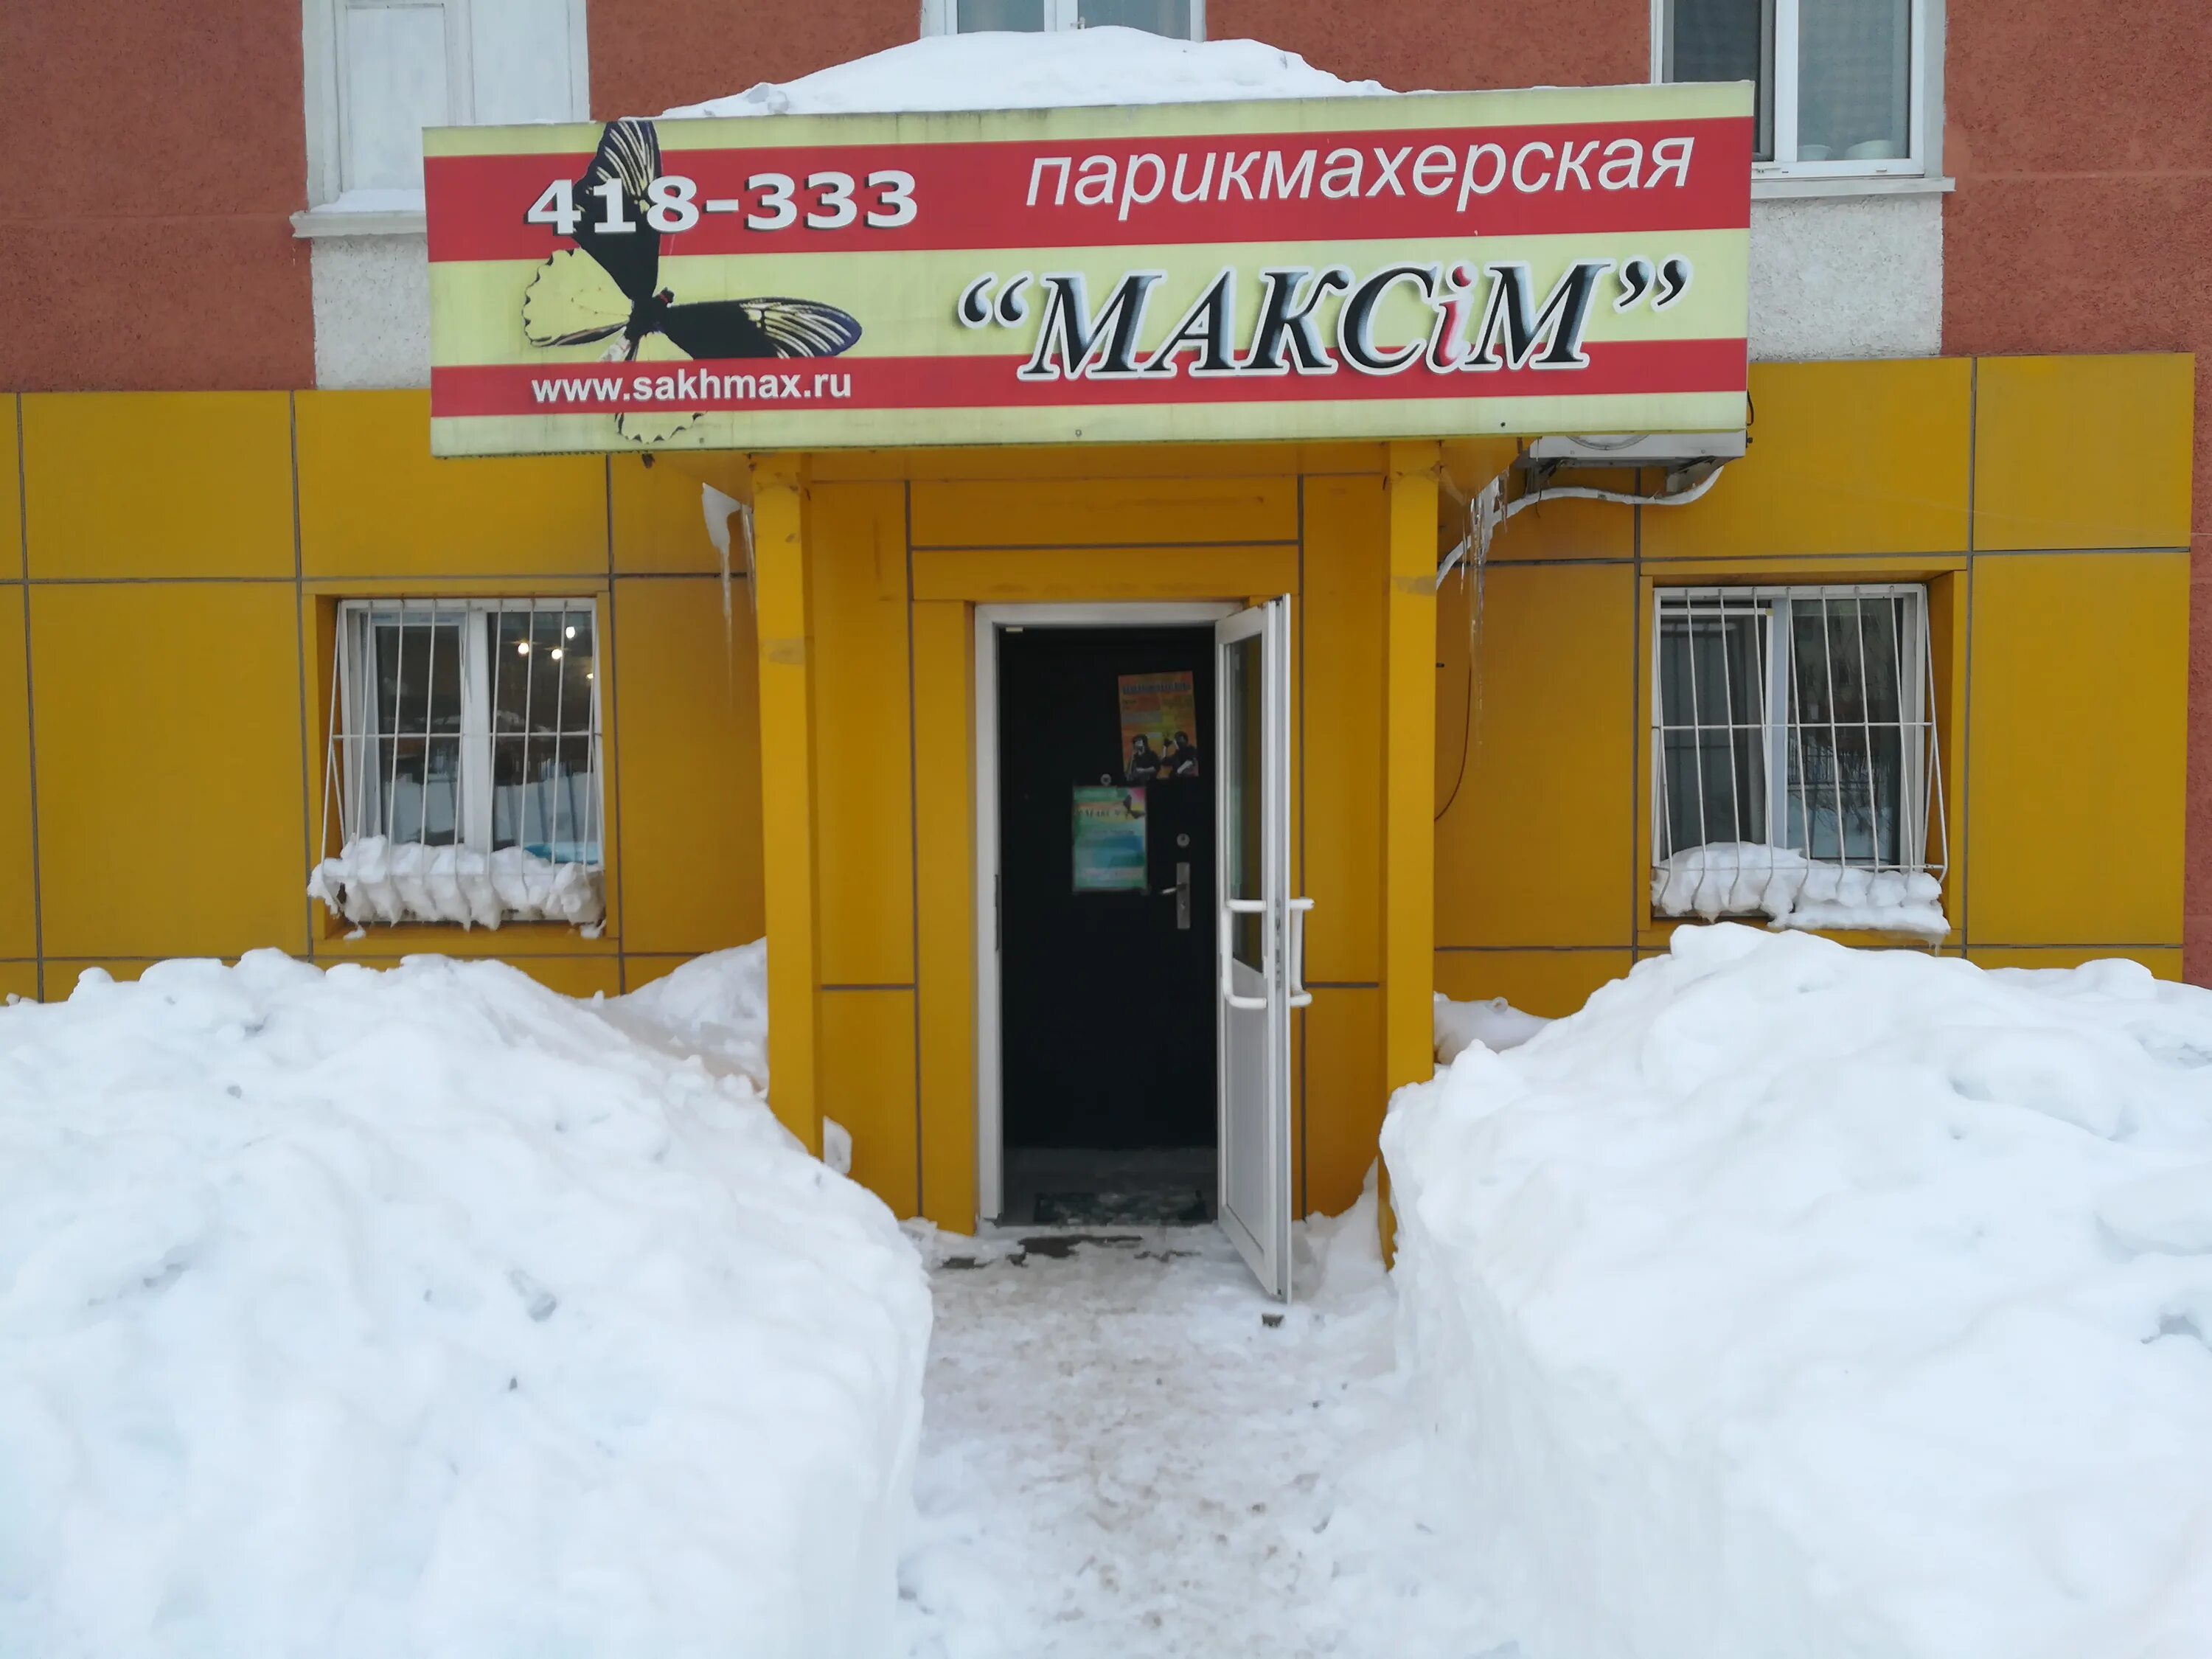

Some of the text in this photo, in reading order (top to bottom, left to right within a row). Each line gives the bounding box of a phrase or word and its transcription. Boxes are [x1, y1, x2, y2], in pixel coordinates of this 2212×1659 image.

[526, 170, 918, 235] 418-333
[1026, 136, 1695, 221] парикмахерская
[532, 368, 851, 403] www.sakhmax.ru
